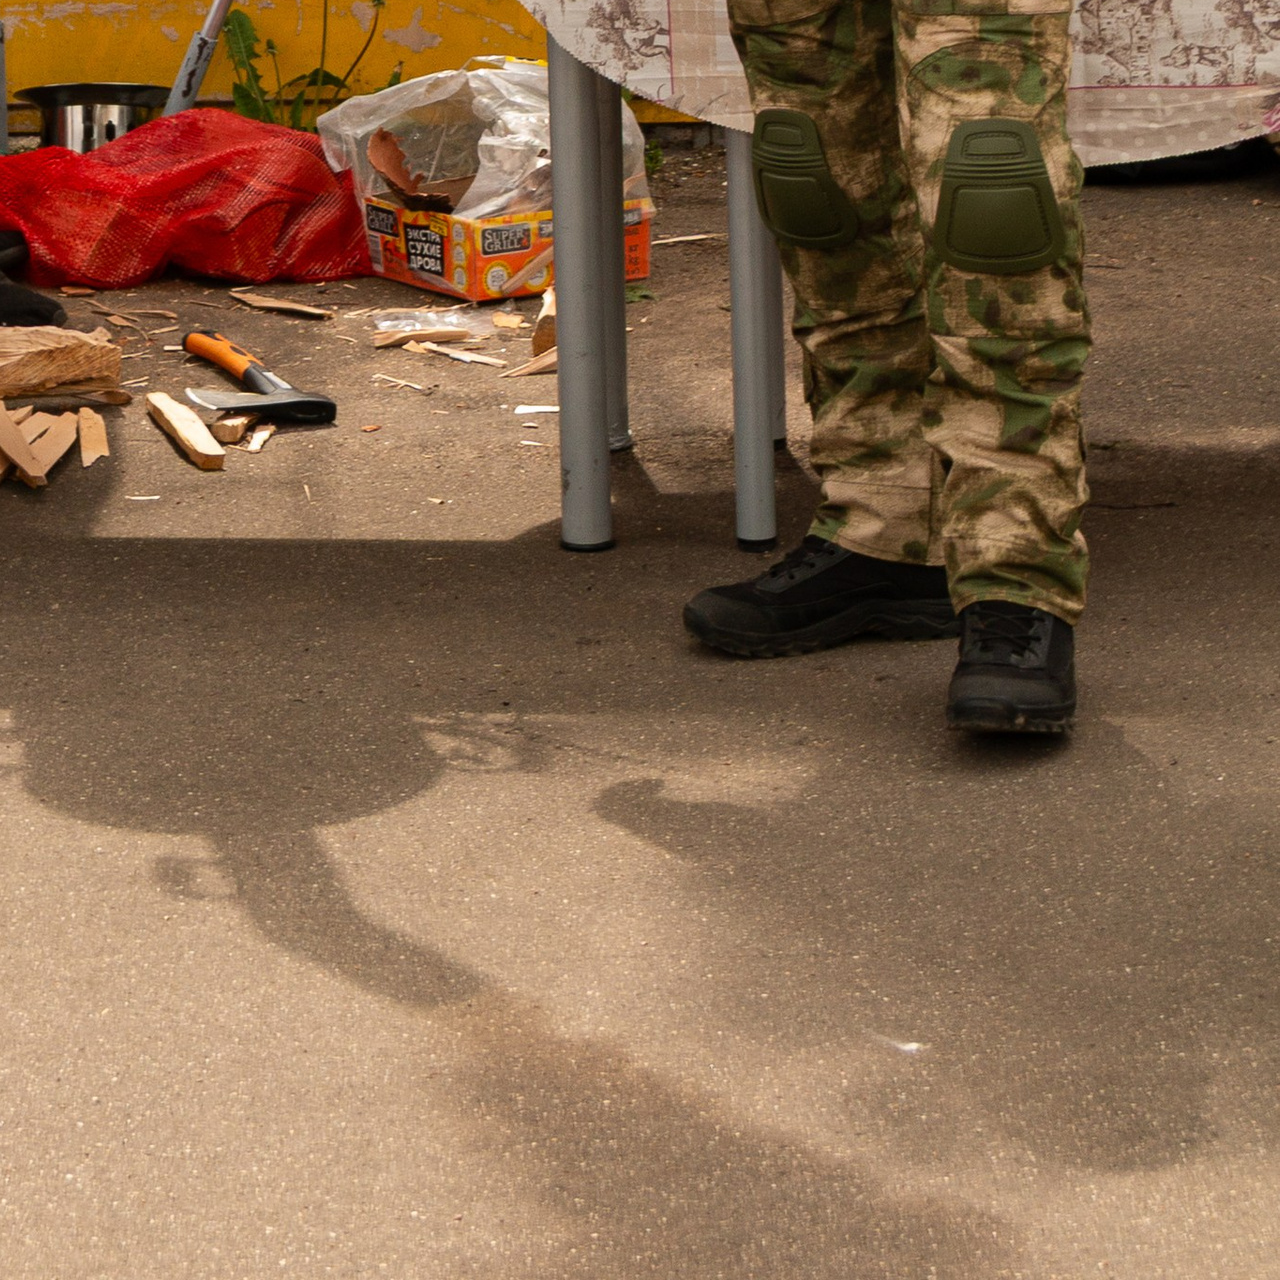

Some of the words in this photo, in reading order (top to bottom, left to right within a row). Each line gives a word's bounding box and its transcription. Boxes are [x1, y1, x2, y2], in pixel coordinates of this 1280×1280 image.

[406, 227, 441, 243] ЭКСТРА
[484, 228, 524, 241] SUPER
[408, 241, 442, 258] СУХИЕ
[483, 238, 522, 252] GRILL
[408, 255, 442, 273] ДРОВА
